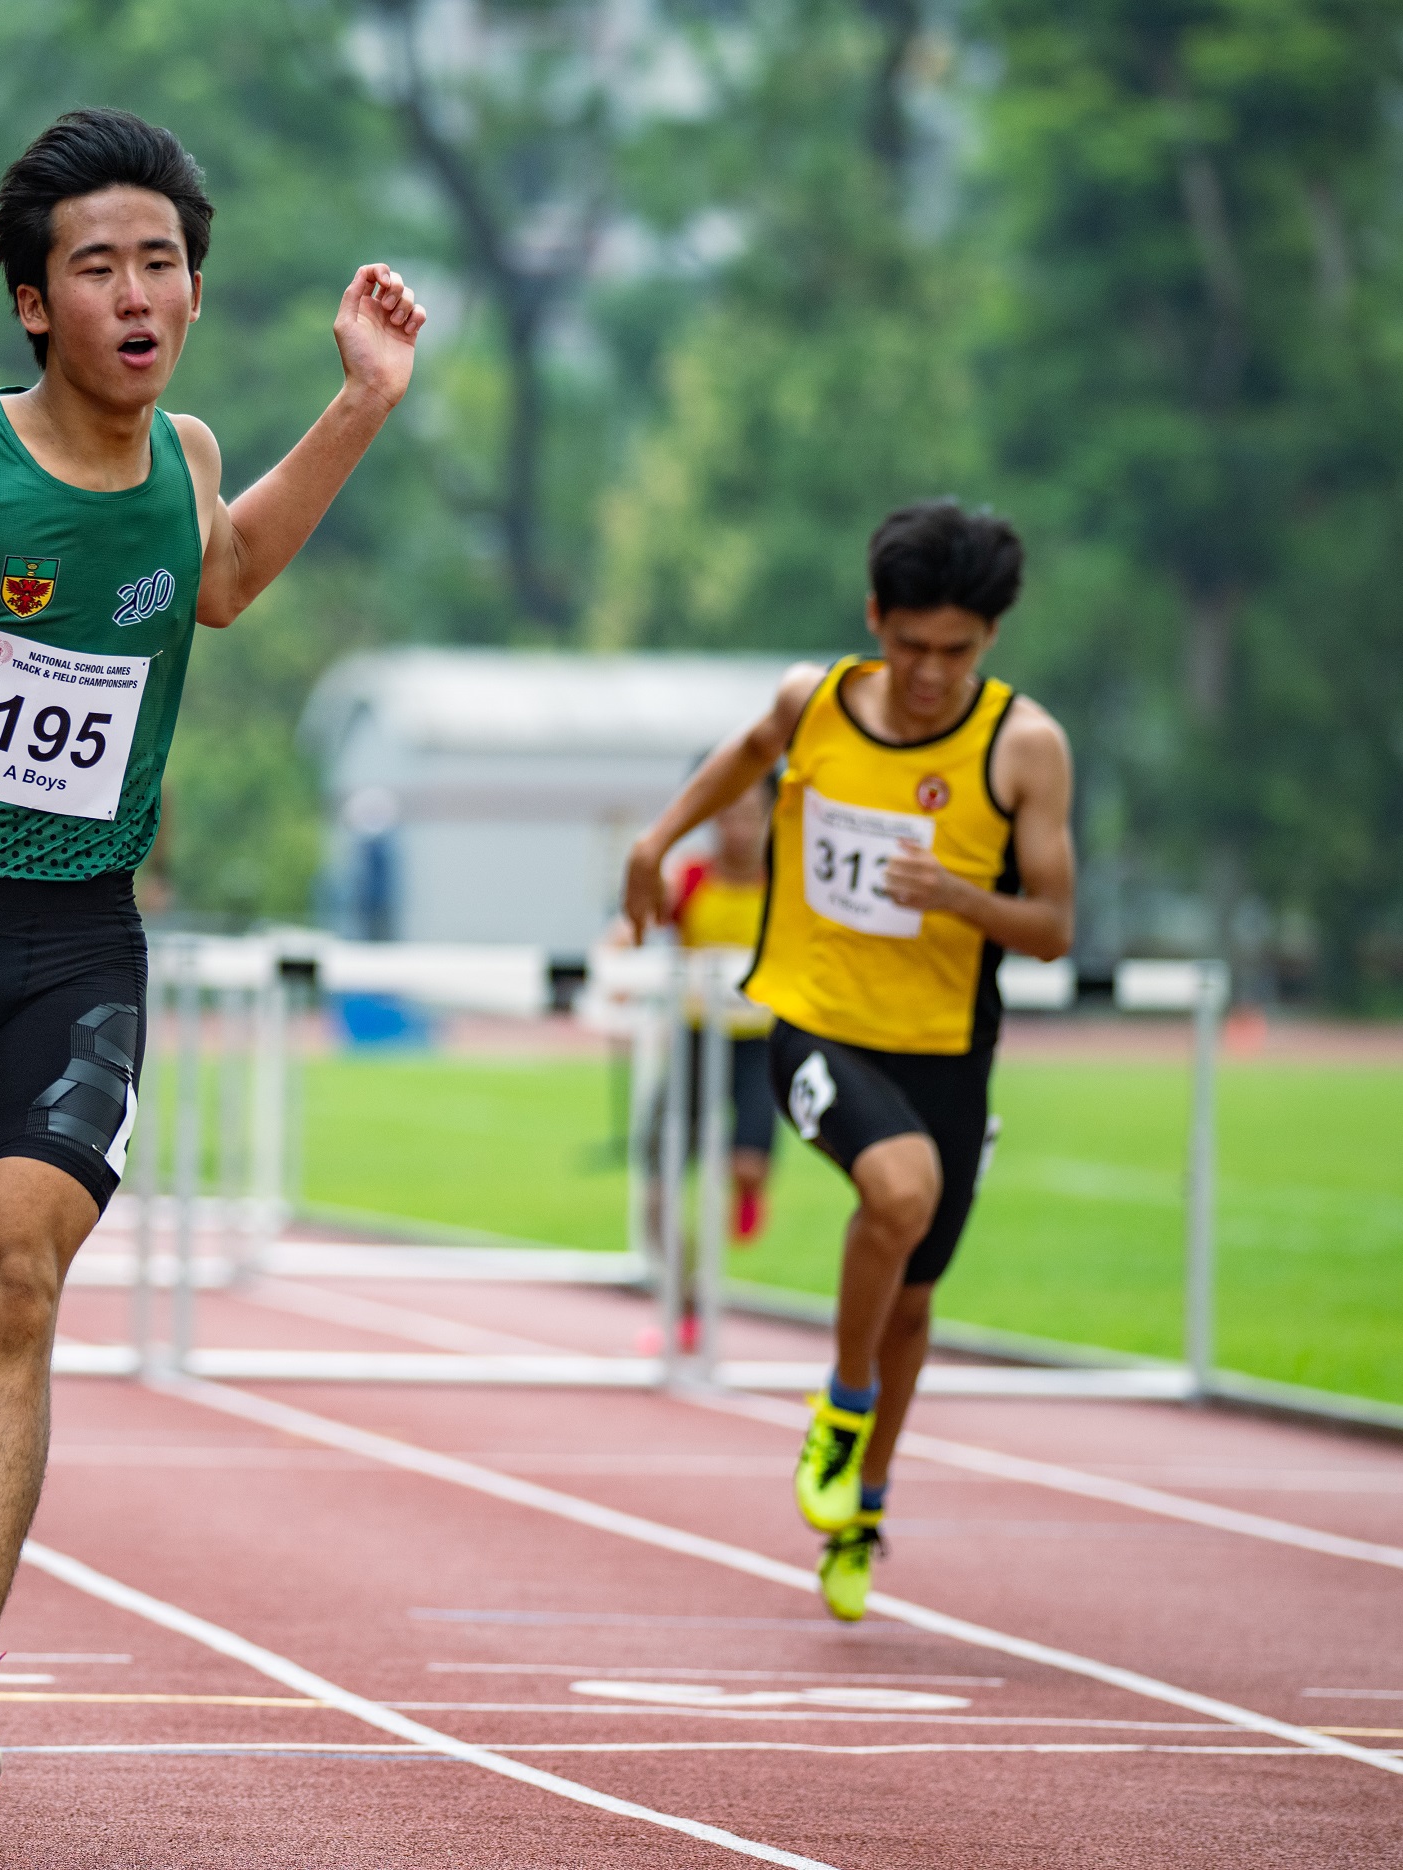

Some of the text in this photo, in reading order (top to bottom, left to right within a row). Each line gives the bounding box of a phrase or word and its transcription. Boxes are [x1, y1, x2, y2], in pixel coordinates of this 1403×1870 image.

[112, 568, 175, 627] 200
[11, 658, 138, 689] TRACK & FIELD CHAMPIONSHIPS
[28, 651, 131, 676] NATIONAL SCHOOL GAMES
[2, 764, 67, 791] A Boys
